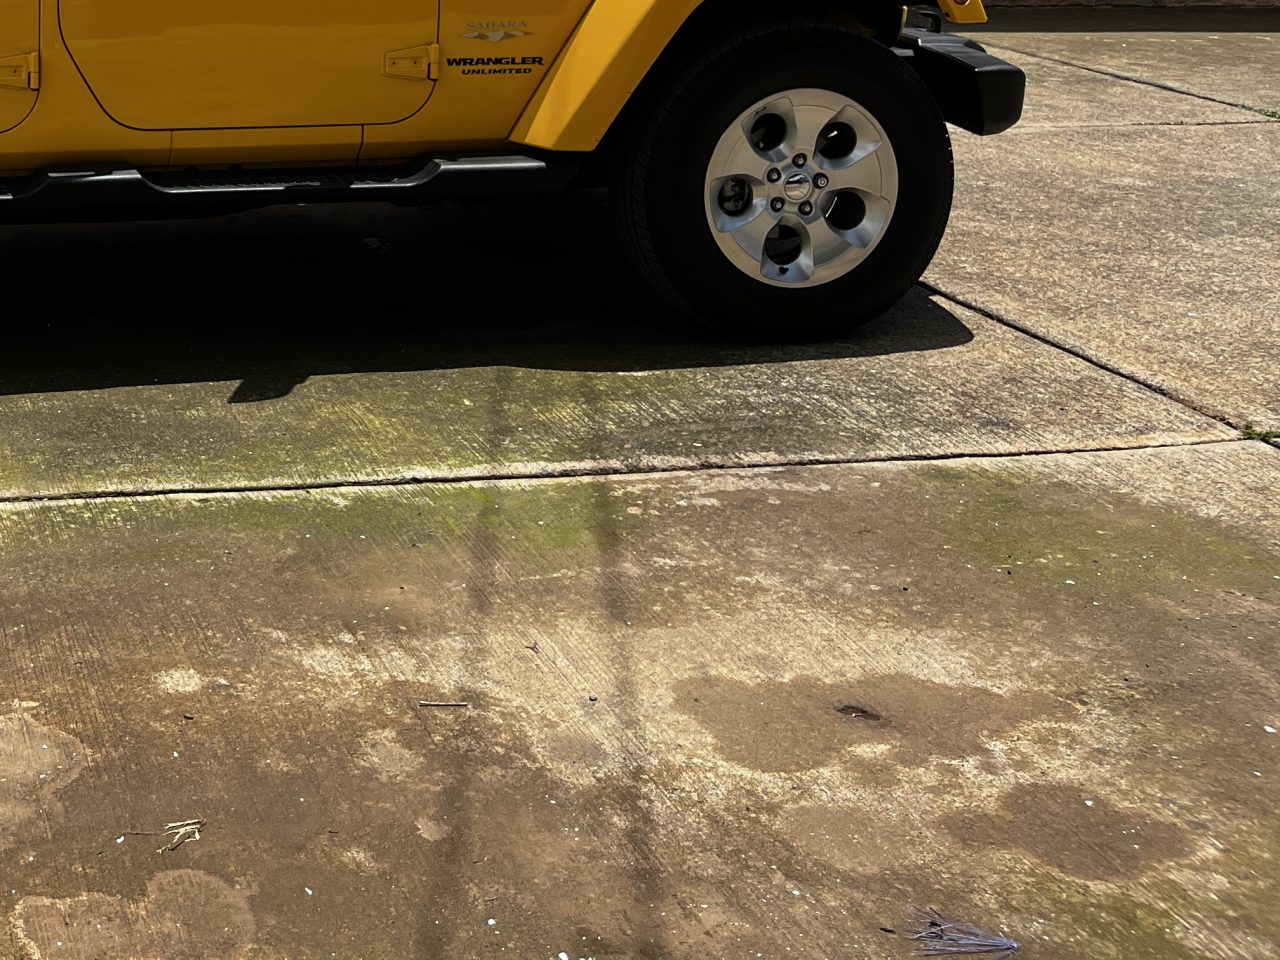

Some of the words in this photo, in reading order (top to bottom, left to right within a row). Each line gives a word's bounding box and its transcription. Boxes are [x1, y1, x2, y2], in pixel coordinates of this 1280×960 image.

[466, 21, 527, 30] SAHARA
[446, 56, 544, 66] WRANGLER
[462, 67, 532, 75] UNLIMITED
